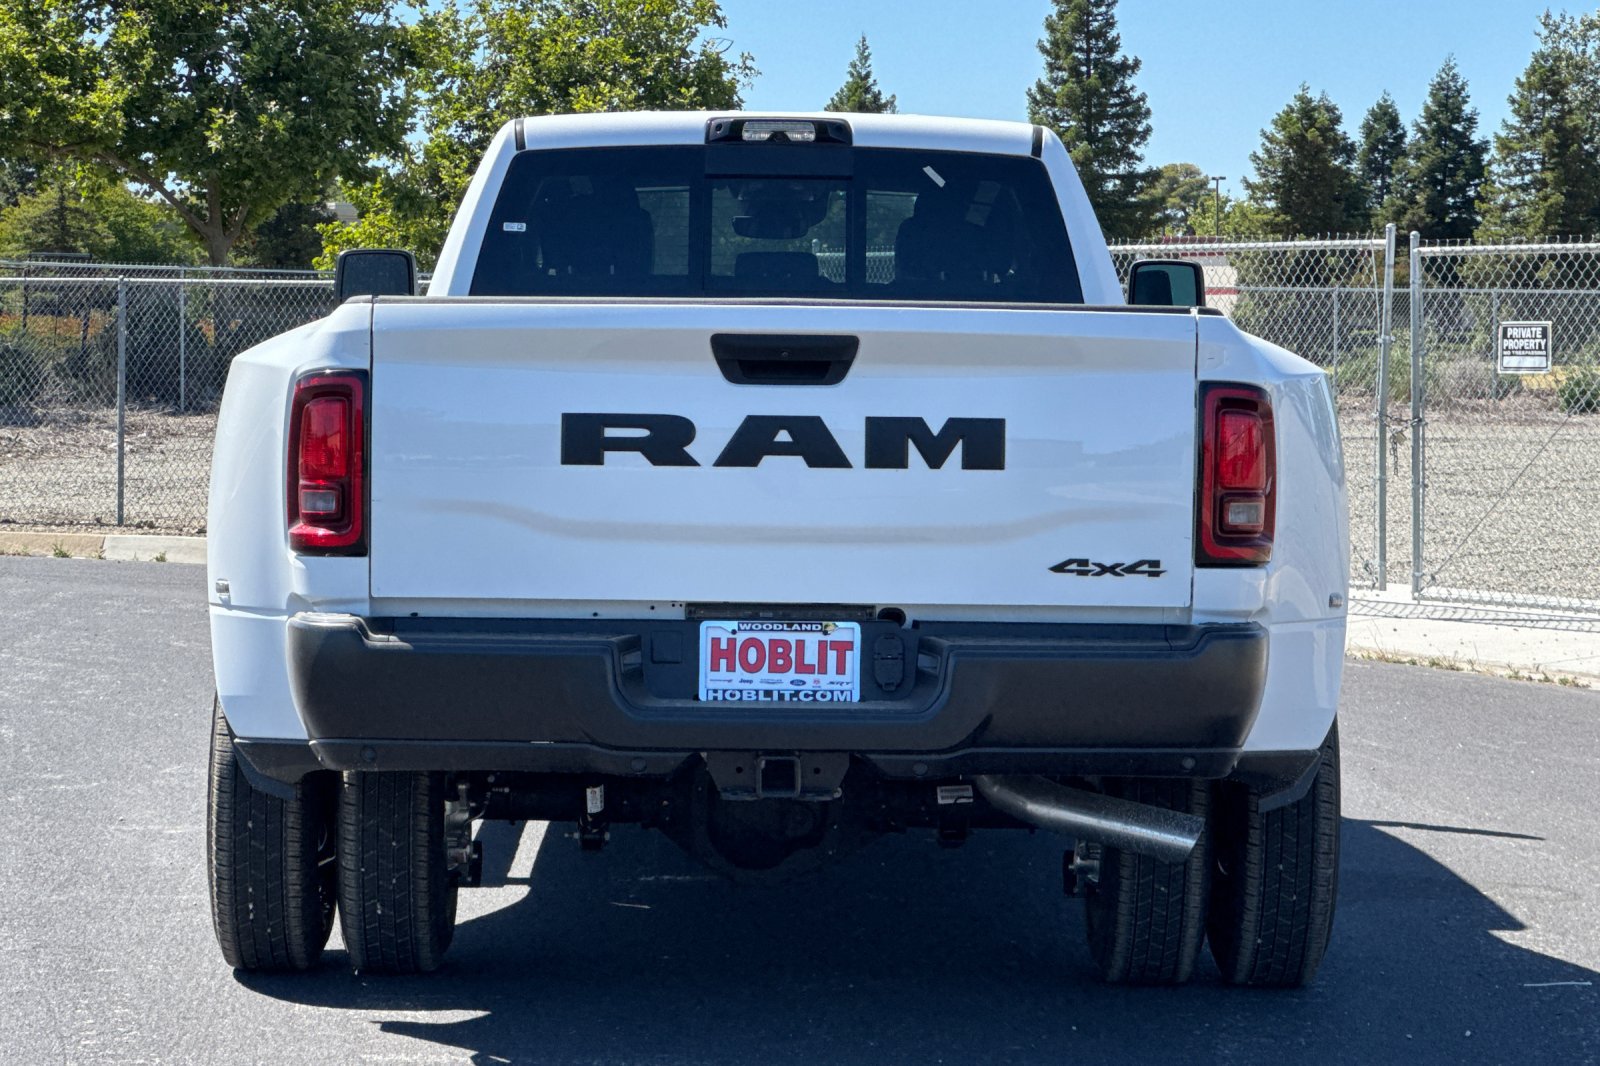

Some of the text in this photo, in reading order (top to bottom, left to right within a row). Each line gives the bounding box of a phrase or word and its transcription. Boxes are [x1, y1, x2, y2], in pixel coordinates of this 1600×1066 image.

[1507, 327, 1542, 338] PRIVATE
[1503, 339, 1546, 350] PROPERTY
[560, 412, 1006, 471] RAM
[1048, 558, 1168, 577] 4x4
[739, 623, 822, 631] WOODLAND
[710, 637, 854, 675] HOBLIT
[708, 690, 852, 702] HOBLIT.COM
